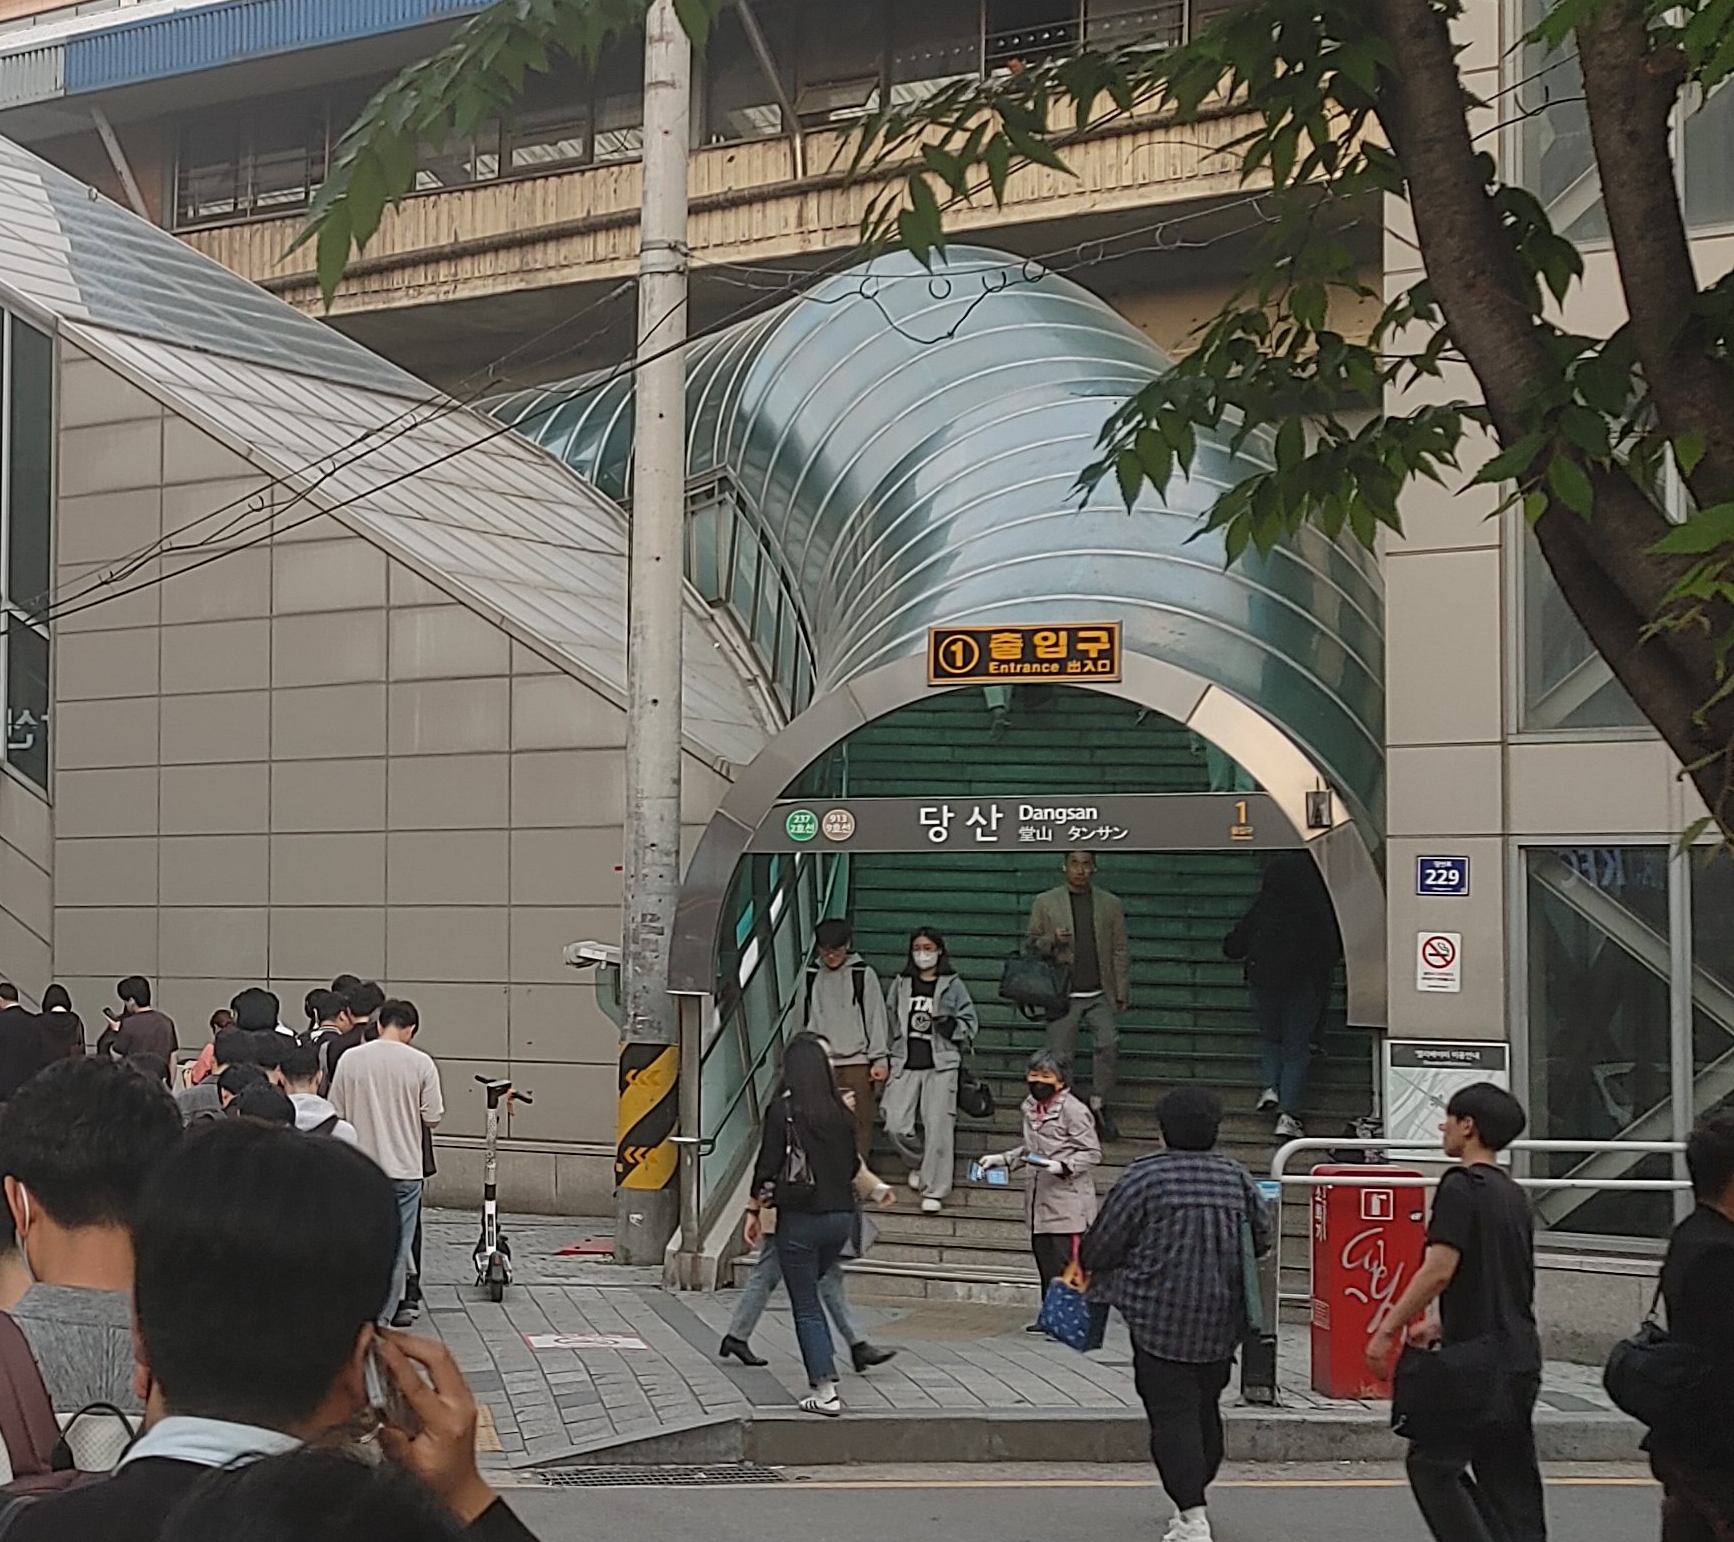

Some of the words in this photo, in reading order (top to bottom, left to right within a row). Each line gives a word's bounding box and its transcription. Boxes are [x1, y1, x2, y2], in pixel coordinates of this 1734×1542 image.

[989, 631, 1111, 660] 출입구
[989, 661, 1060, 674] Entrance
[1018, 804, 1098, 825] Dangsan
[1235, 801, 1246, 824] 1
[1018, 825, 1053, 841] 堂山
[1067, 825, 1129, 841] タンサン
[1425, 869, 1460, 885] 229
